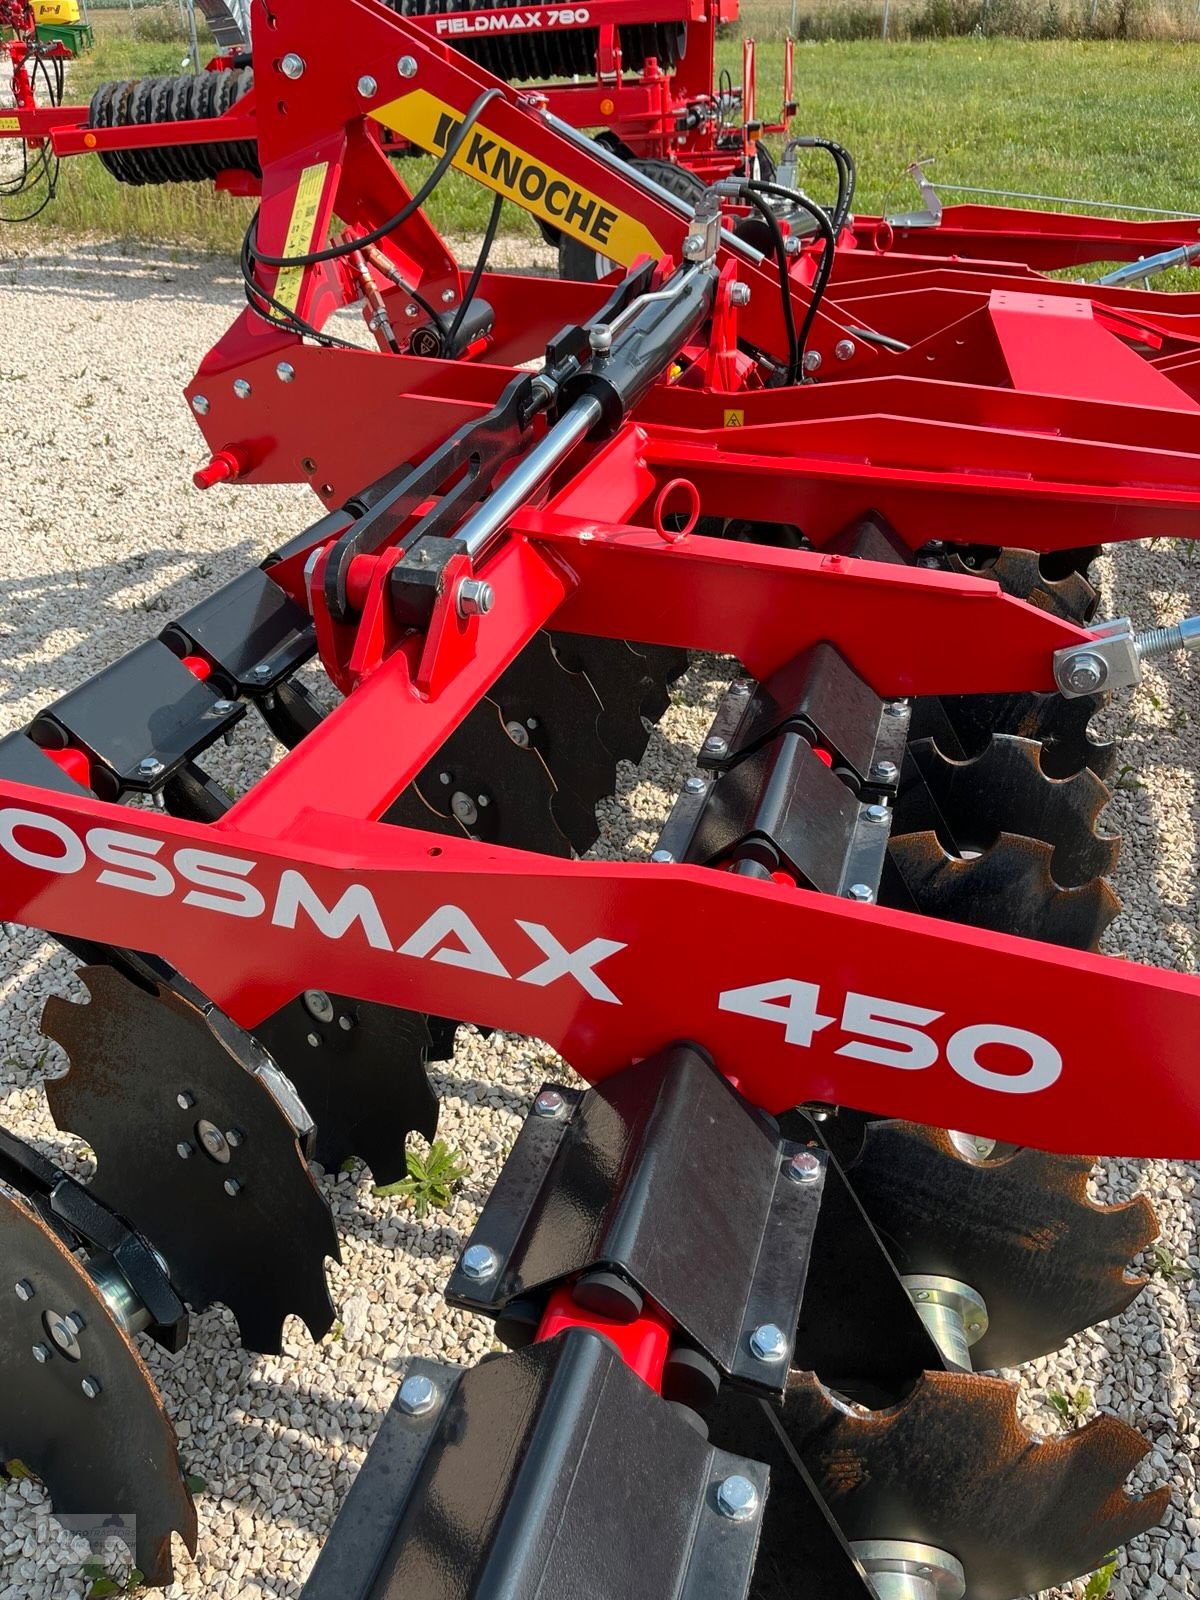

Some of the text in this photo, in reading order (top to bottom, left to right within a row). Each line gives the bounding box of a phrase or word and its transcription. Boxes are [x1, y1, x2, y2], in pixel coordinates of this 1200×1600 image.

[435, 8, 590, 35] FIELDMAX 780
[466, 132, 618, 245] KNOCHE
[718, 978, 1063, 1094] 450
